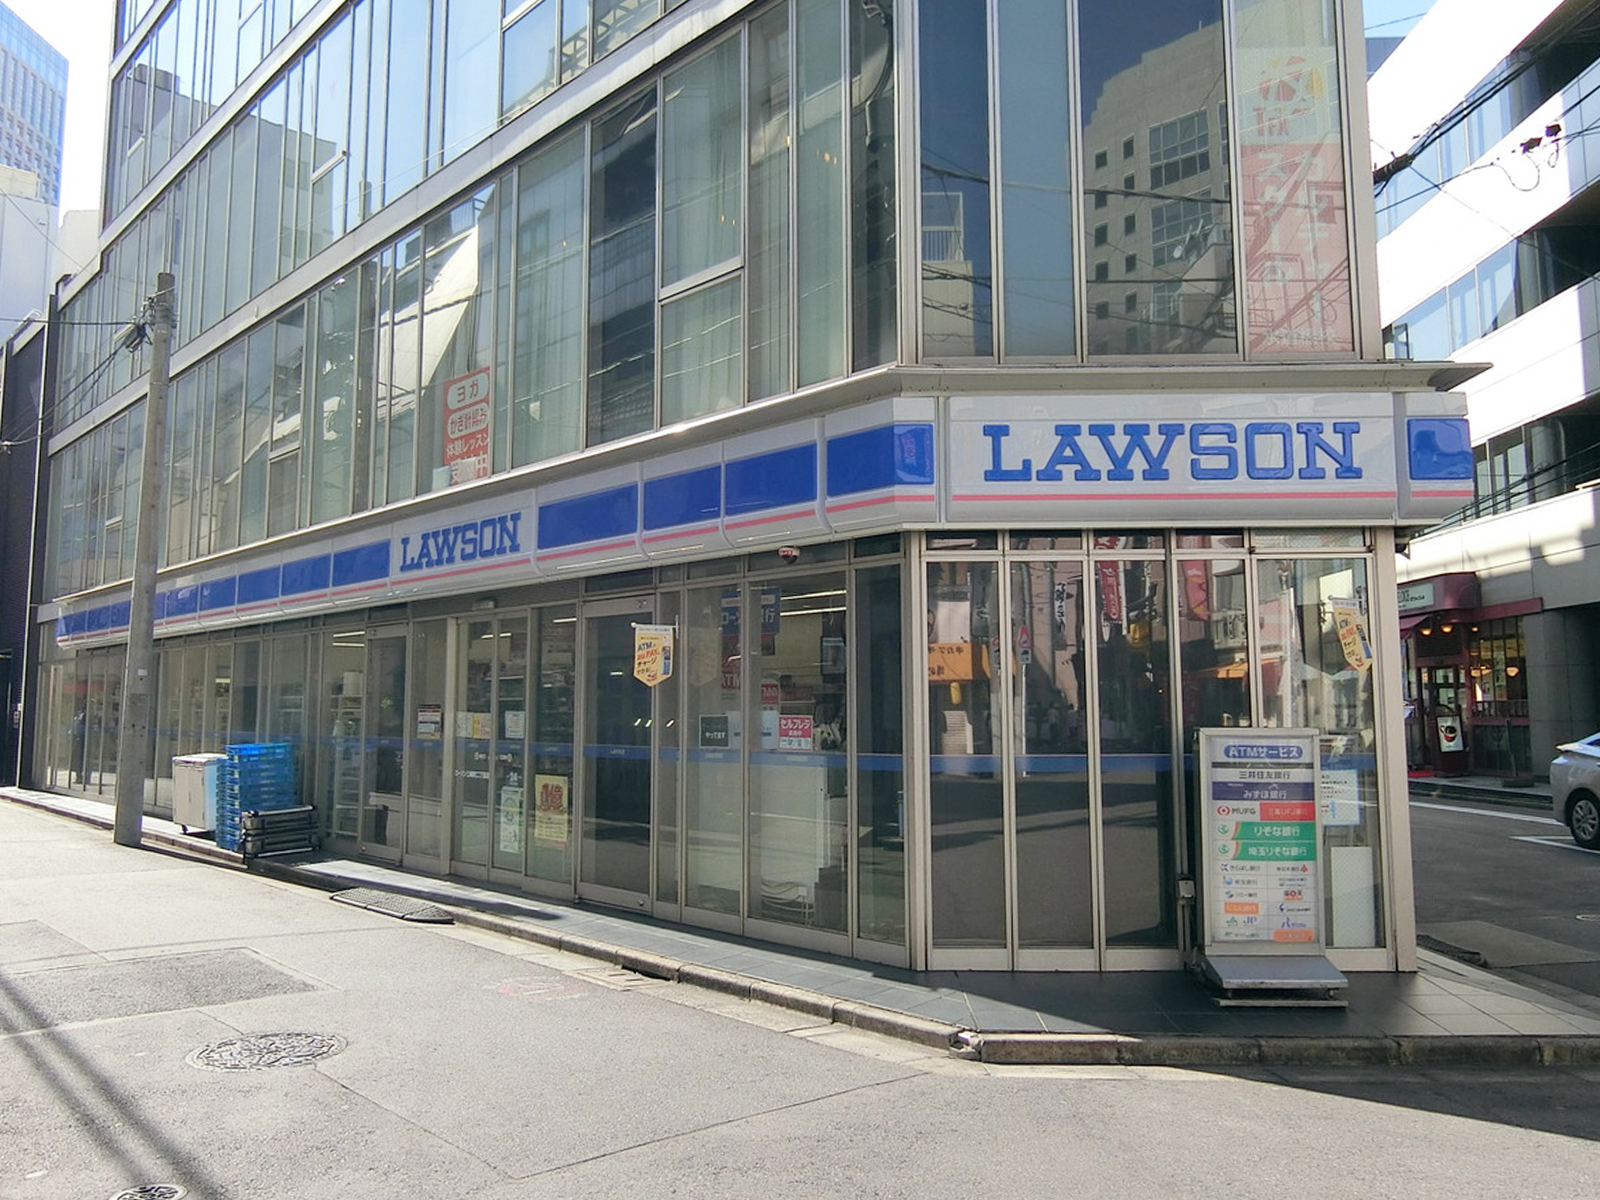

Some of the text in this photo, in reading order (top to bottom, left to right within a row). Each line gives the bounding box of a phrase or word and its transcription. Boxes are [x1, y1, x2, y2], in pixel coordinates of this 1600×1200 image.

[457, 380, 479, 403] ヨガ
[983, 421, 1363, 482] LAWSON
[450, 451, 488, 484] 受中
[400, 511, 522, 572] LAWSON
[780, 718, 811, 729] セルフレジ
[705, 731, 726, 739] やってます
[1229, 746, 1299, 757] ATMサービス
[1238, 771, 1291, 779] 三井住友銀行
[1243, 790, 1287, 799] みずほ銀行
[1253, 826, 1300, 837] りそな銀行
[1248, 846, 1307, 857] 埼玉りそな銀行
